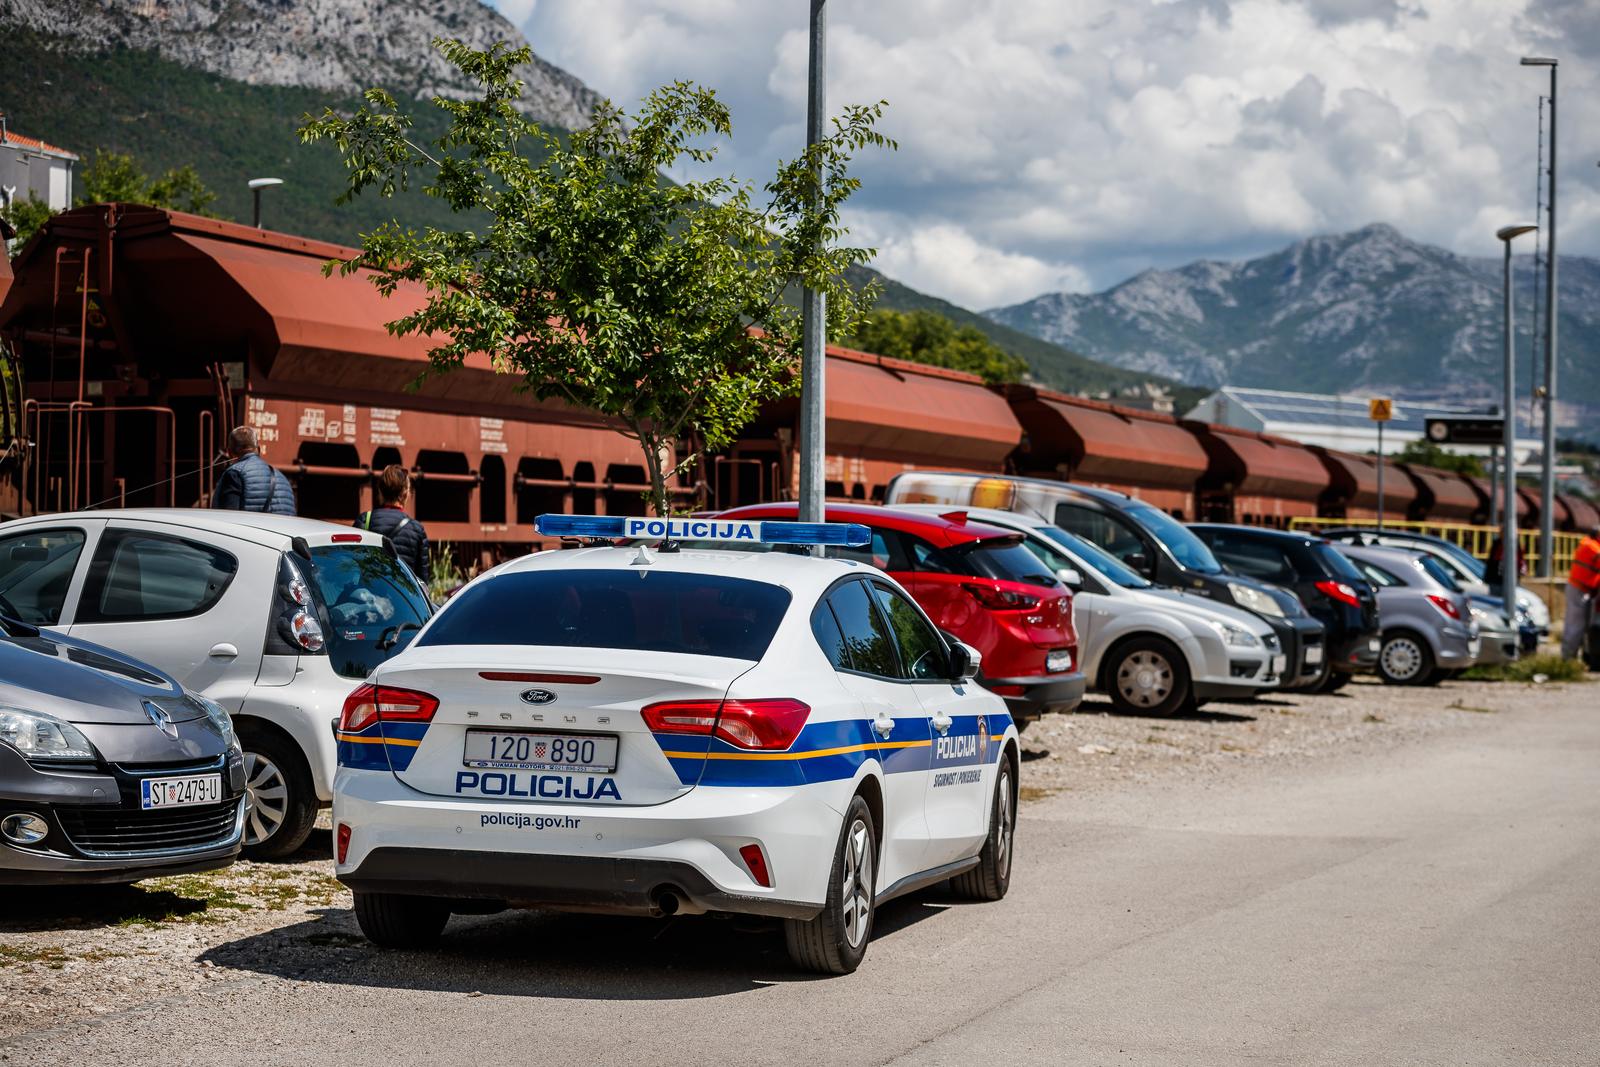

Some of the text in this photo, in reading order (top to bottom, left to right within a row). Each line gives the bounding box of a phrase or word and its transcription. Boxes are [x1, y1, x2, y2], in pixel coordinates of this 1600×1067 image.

[630, 521, 753, 538] POLICIJA
[527, 690, 549, 701] Ford
[467, 711, 610, 724] FOCUS
[491, 737, 594, 763] 120 890
[937, 735, 976, 759] POLICIJA
[152, 783, 167, 804] ST
[456, 772, 622, 800] POLICIJA
[481, 813, 580, 829] policija.gov.hr
